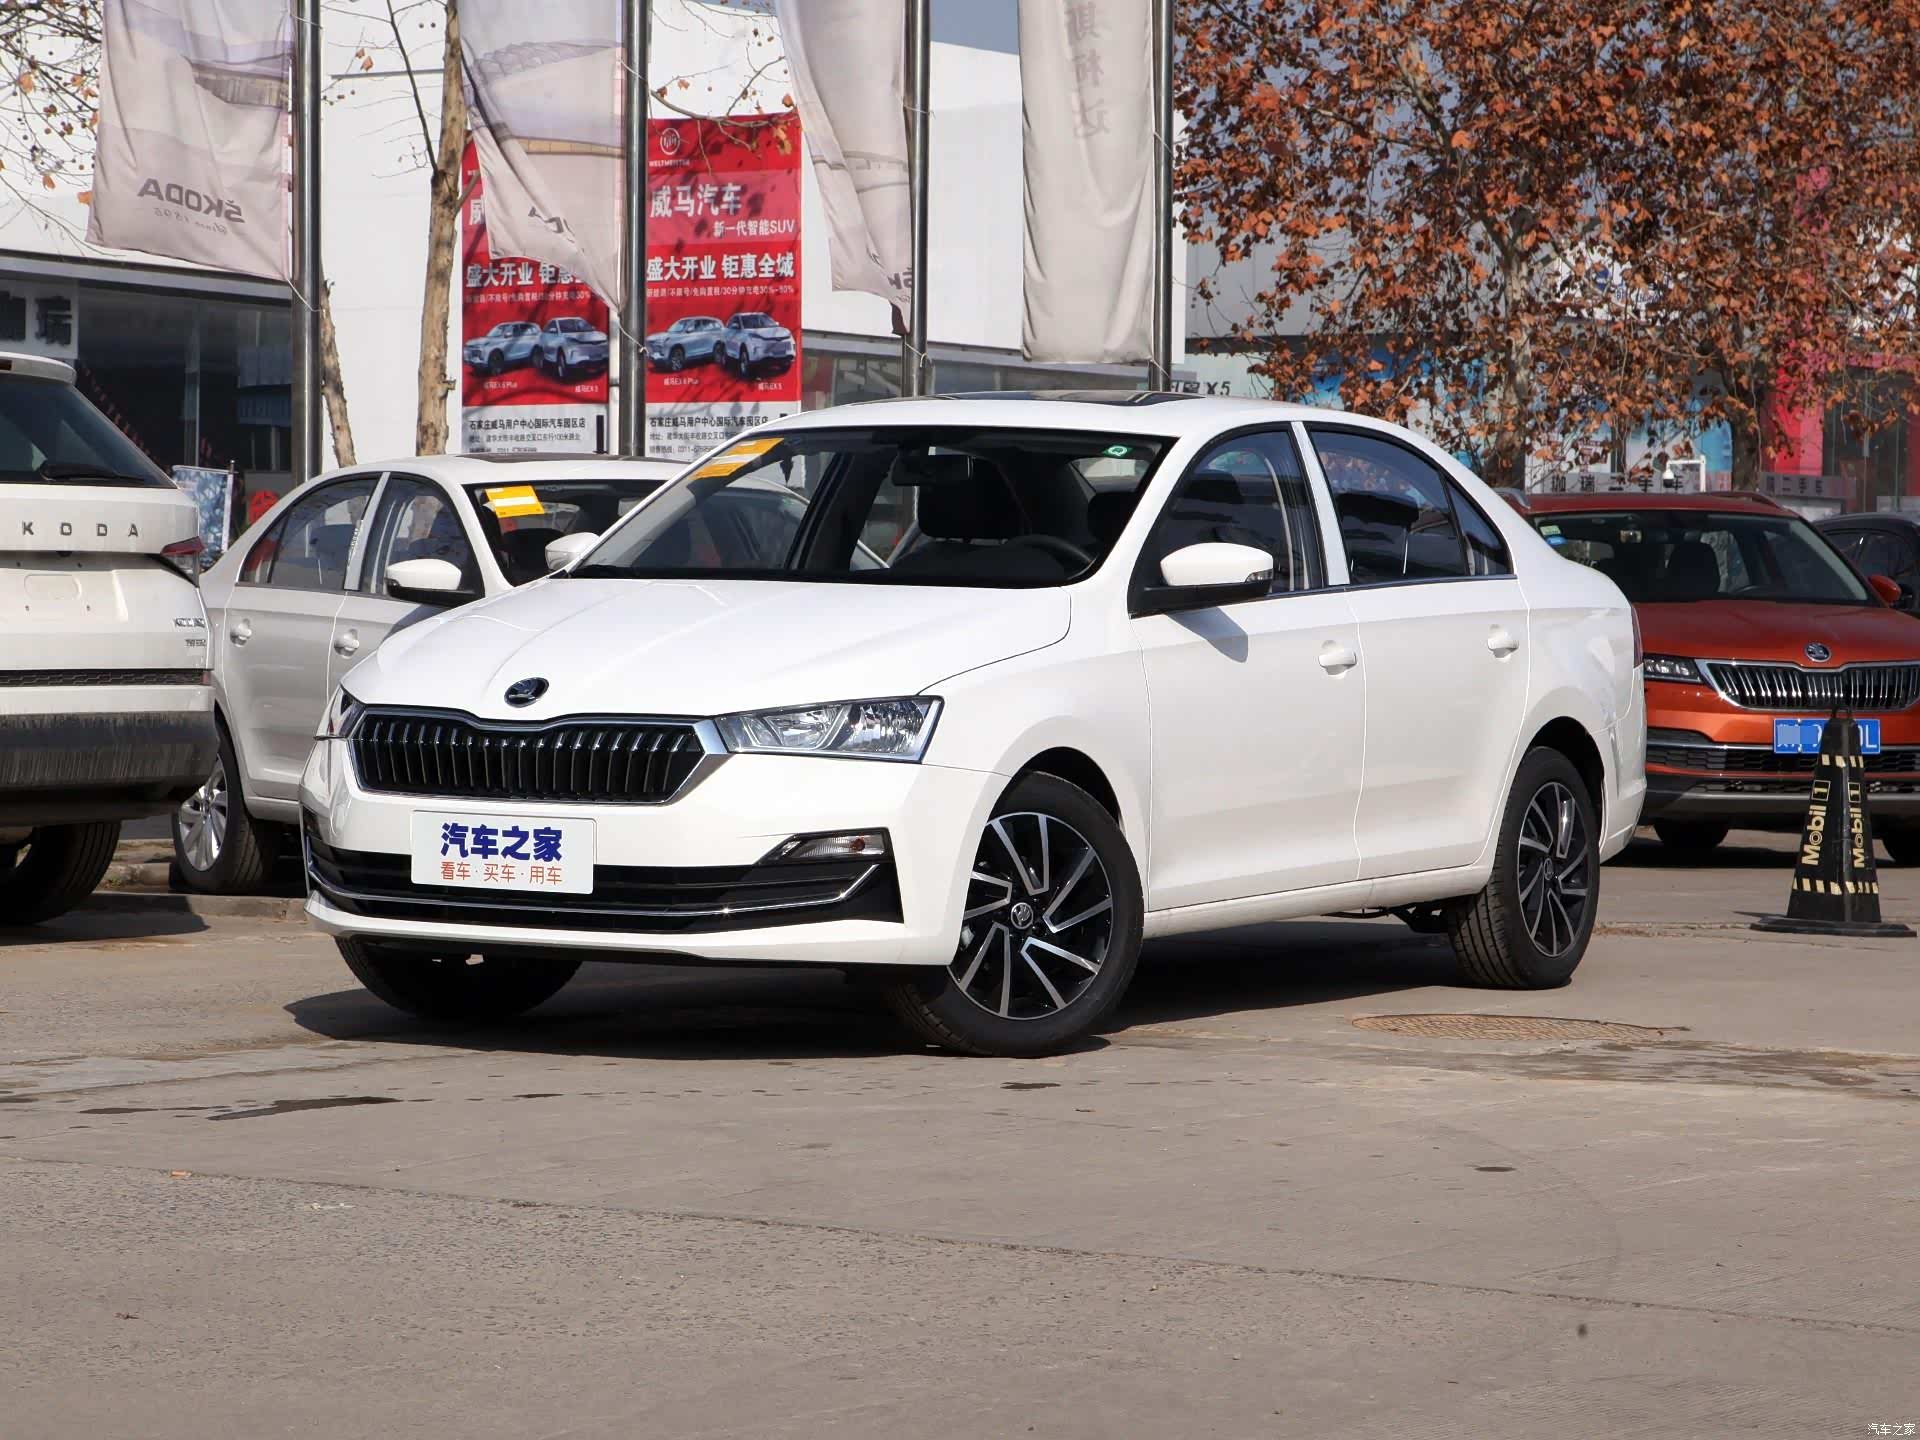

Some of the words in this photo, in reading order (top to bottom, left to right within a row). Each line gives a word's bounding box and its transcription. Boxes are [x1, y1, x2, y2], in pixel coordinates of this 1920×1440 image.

[650, 182, 742, 218] 威马汽车
[713, 219, 796, 238] 新一代智能SUV
[466, 261, 534, 288] 盛大开业
[646, 255, 717, 283] 盛大开业
[721, 252, 795, 280] 钜惠全城
[440, 822, 563, 862] 汽车之家
[1801, 804, 1827, 866] Mobil
[1850, 807, 1866, 869] Mobil
